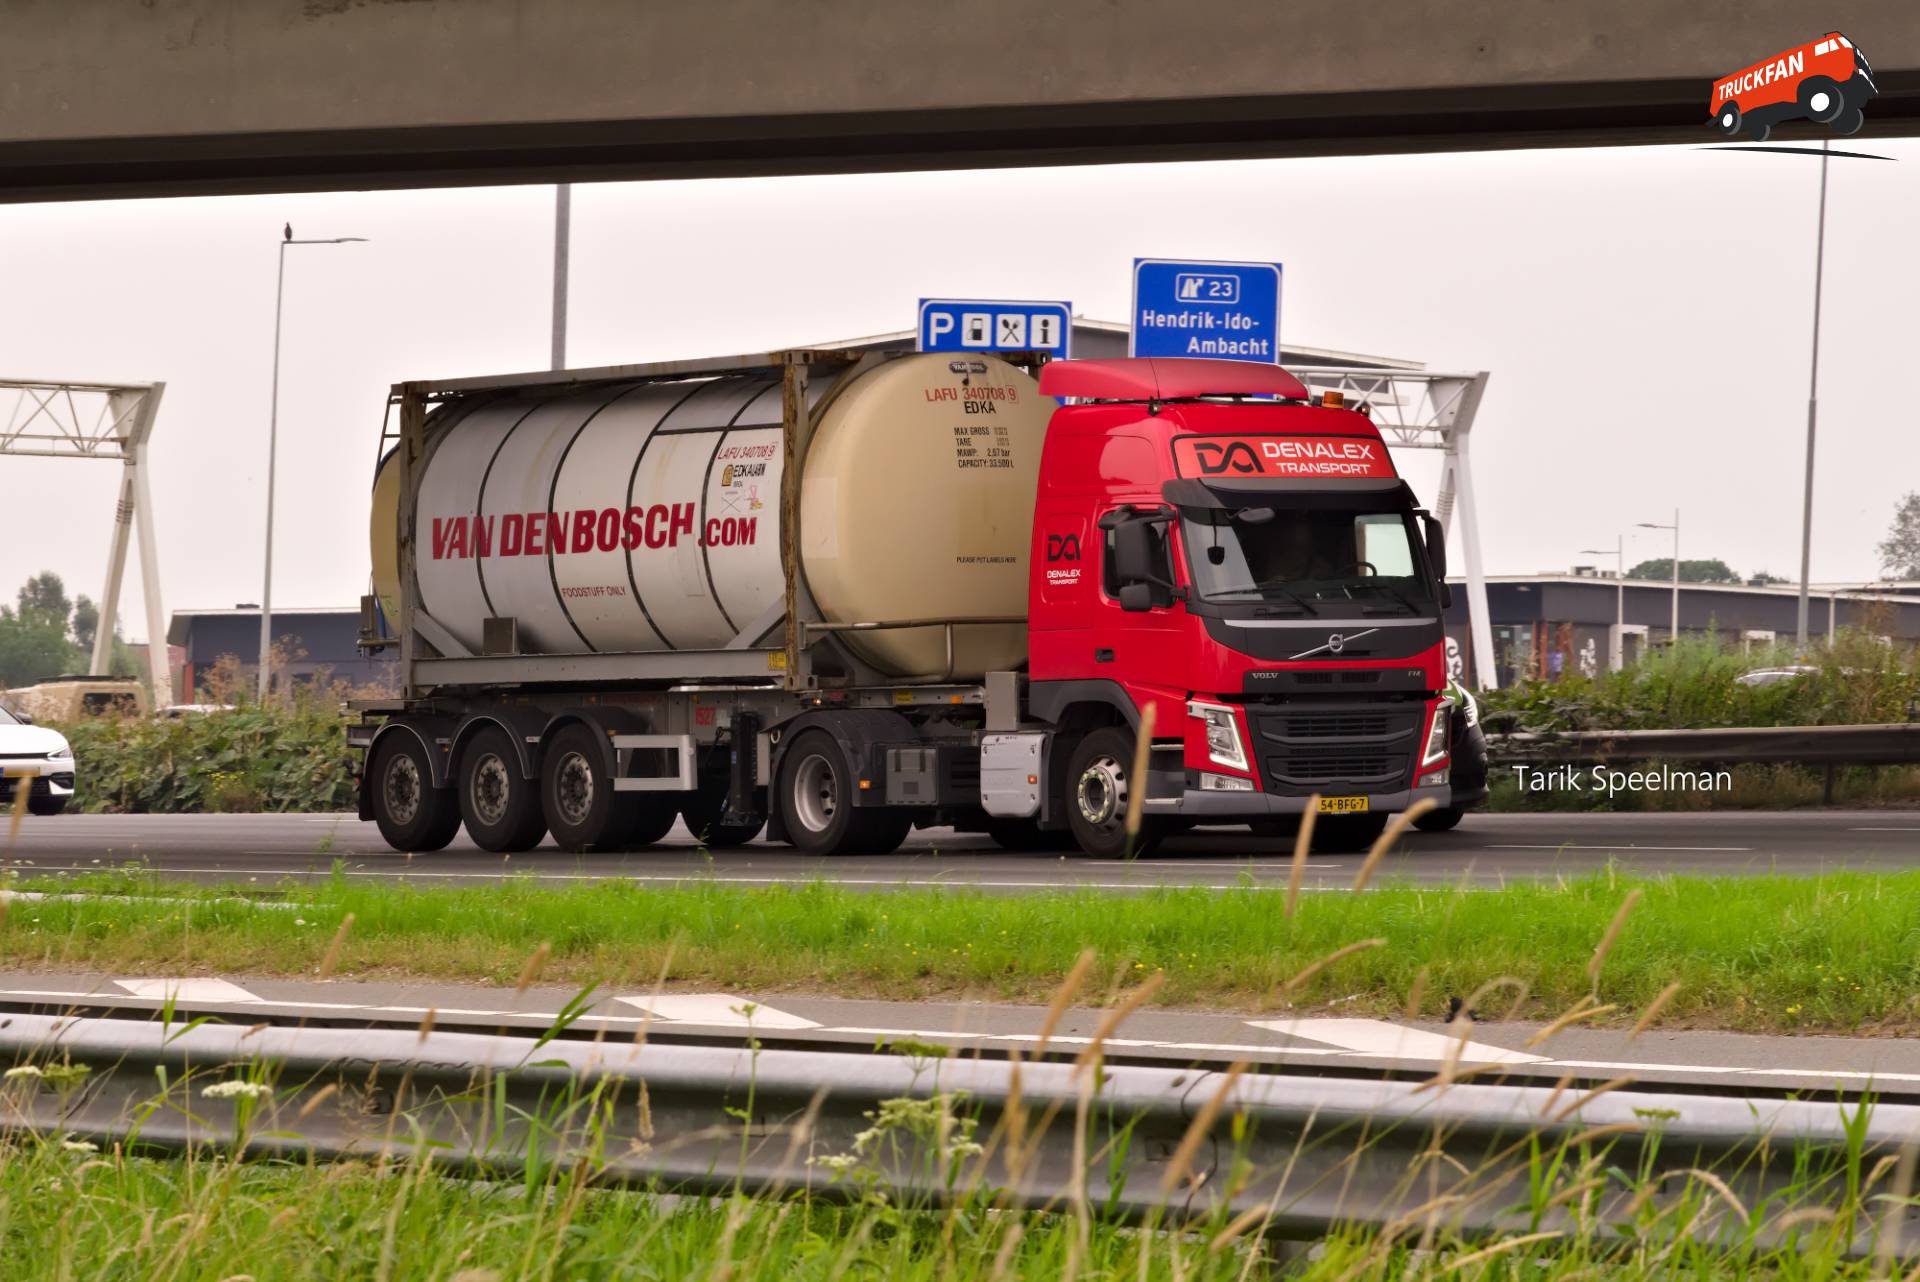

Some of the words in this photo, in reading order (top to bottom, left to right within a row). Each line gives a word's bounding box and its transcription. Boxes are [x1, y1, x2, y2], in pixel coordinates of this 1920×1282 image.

[1208, 281, 1233, 296] 23
[1142, 309, 1260, 330] Hendrik-Ido-
[929, 312, 955, 346] P
[1187, 336, 1268, 355] Ambacht
[925, 387, 958, 402] LAFU
[962, 386, 1006, 401] 340708
[964, 401, 996, 414] EDKA
[718, 447, 741, 460] LAFU
[1261, 442, 1375, 460] DENALEX
[1276, 462, 1371, 475] TRANSPORT
[433, 514, 495, 560] VAN
[1046, 569, 1081, 579] DENALEX
[561, 586, 605, 598] FOODSTUFF
[606, 585, 626, 597] ONLY
[1321, 798, 1365, 811] 54-BFG-7
